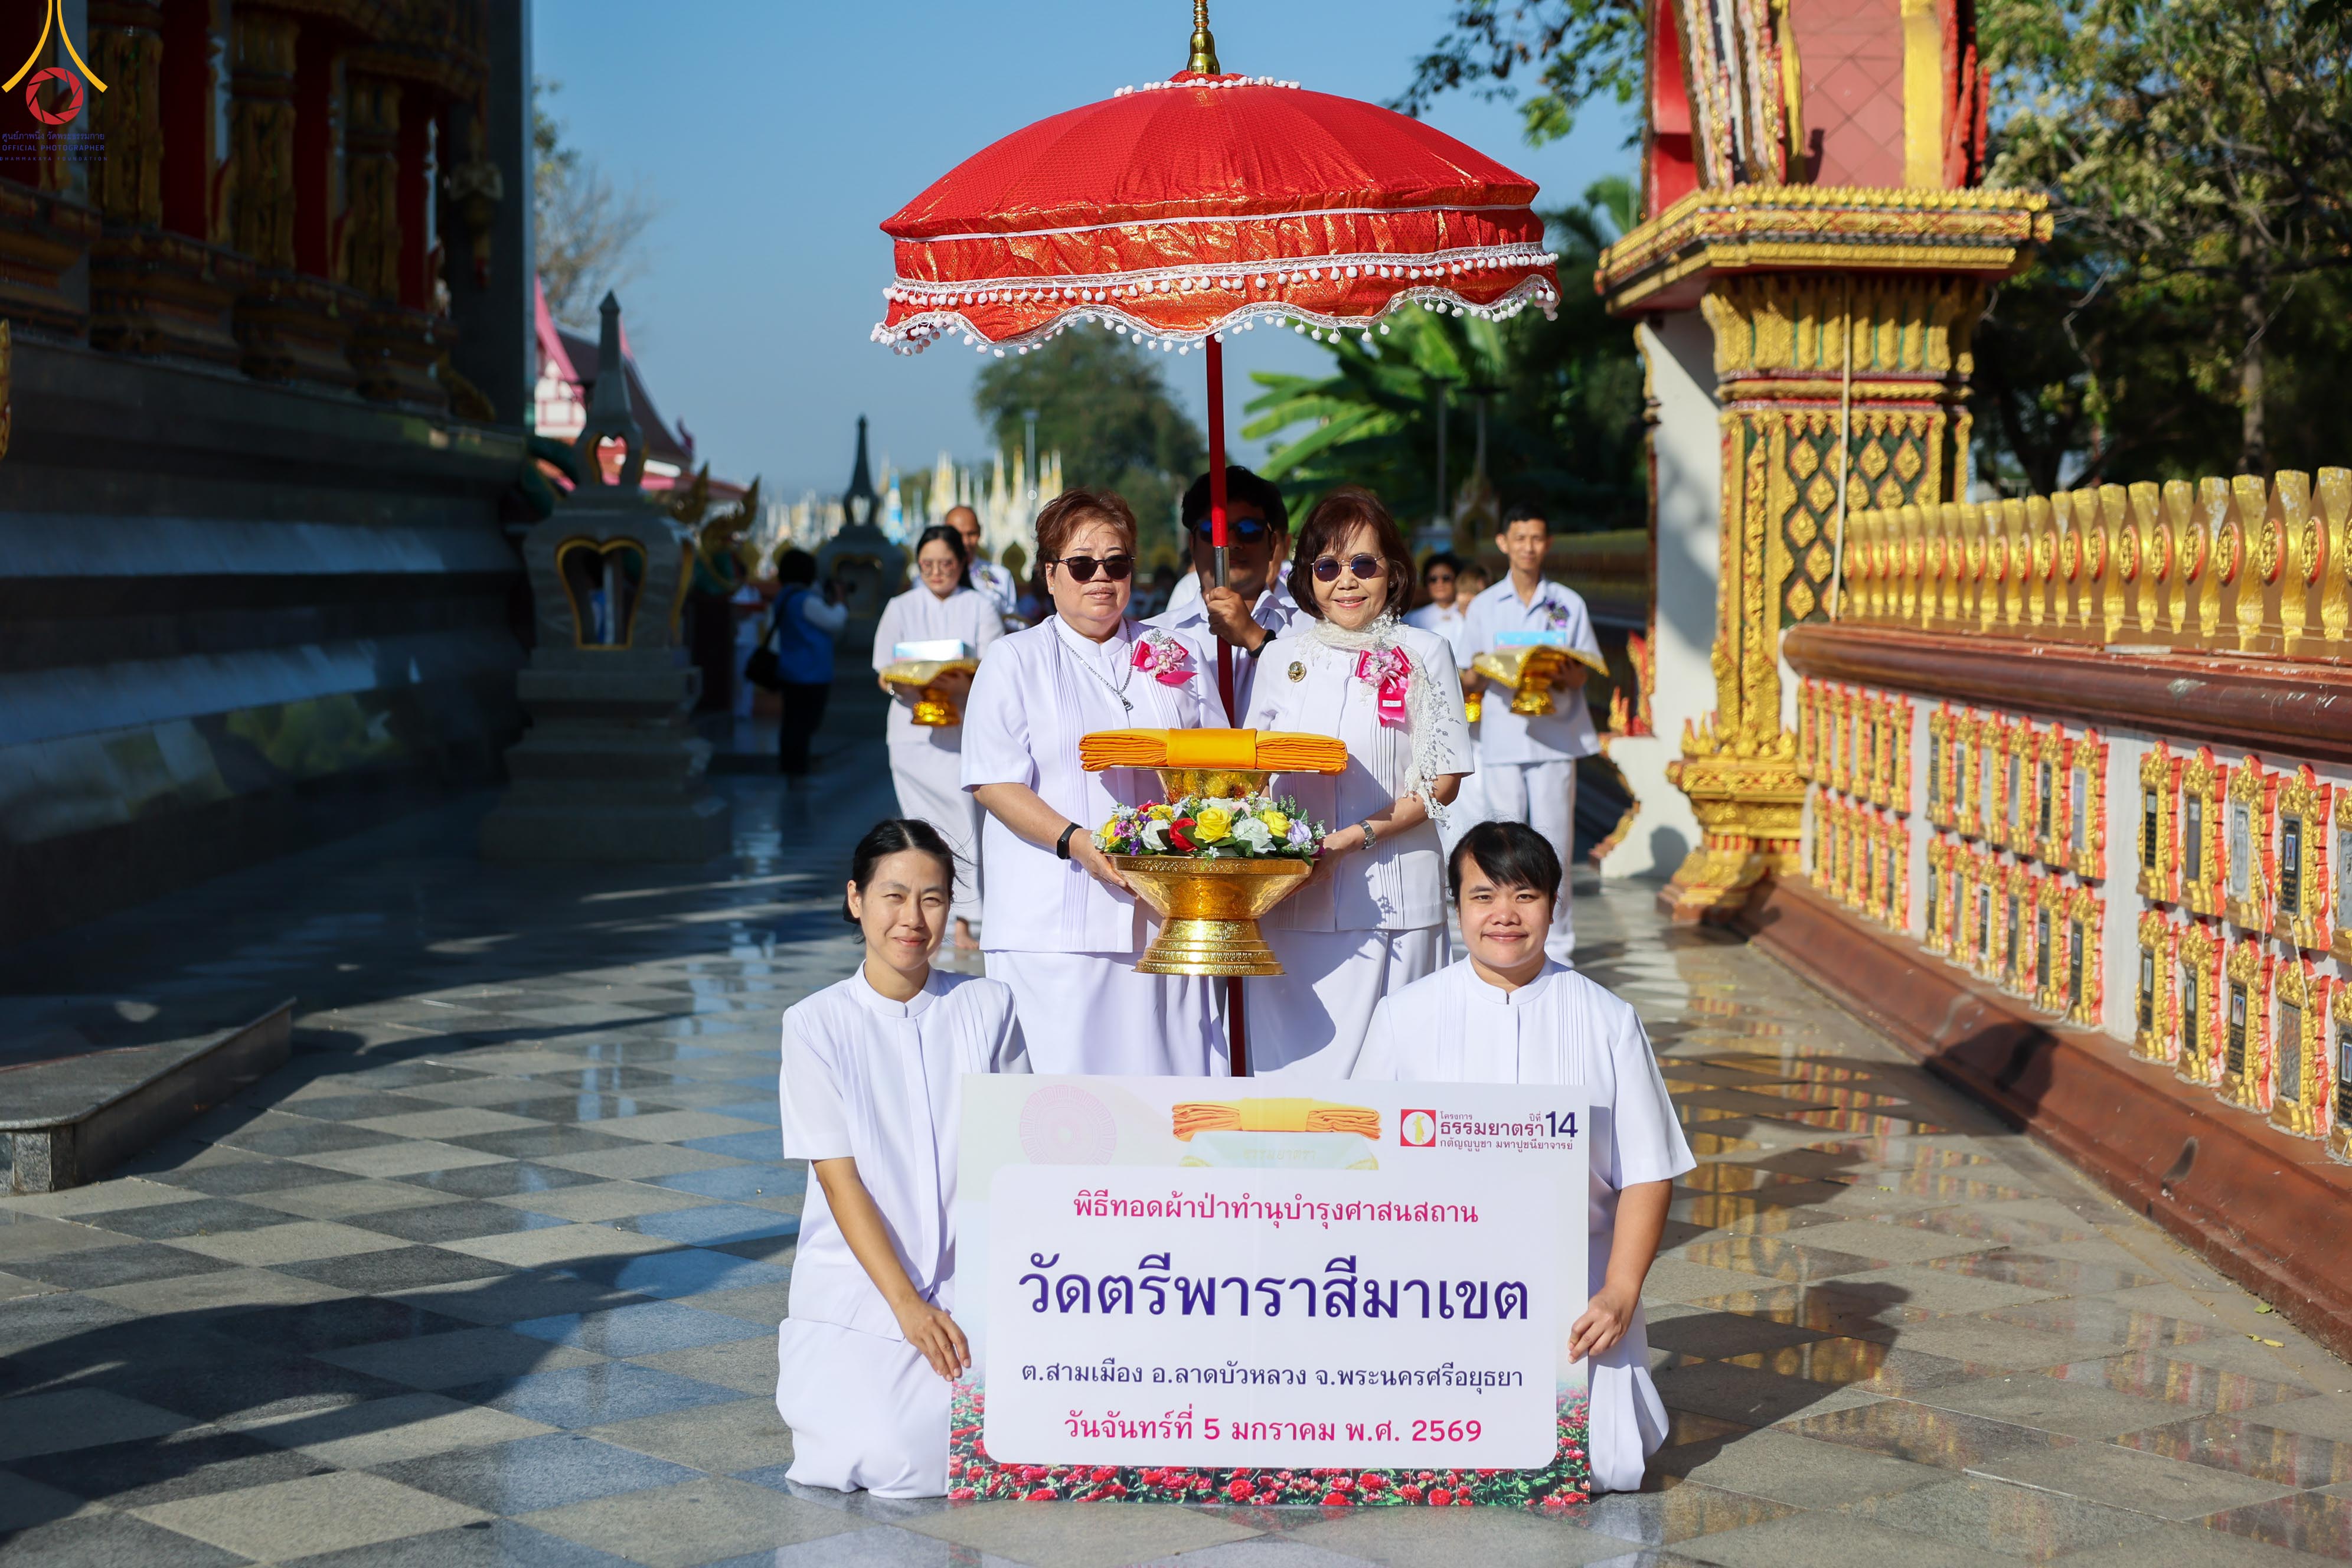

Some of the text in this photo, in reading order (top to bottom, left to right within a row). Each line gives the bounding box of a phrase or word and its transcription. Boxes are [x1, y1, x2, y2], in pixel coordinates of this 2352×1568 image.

[1440, 1110, 1473, 1121] โครงการ
[1440, 1121, 1544, 1136] ธรรมยาตรา
[1529, 1110, 1579, 1138] ปีที่ 14
[1073, 1189, 1479, 1230] พิธีทอดผ้าป่าทำนุบำรุงศาสนสถาน
[1018, 1252, 1528, 1320] วัดตรีพาราสีมาเขต
[1022, 1357, 1523, 1395] ต.สามเมือง อ.ลาดบัวหลวง จ.พระนครศรีอยุธยา
[1064, 1403, 1482, 1442] วันจันทร์ที่ 5 มกราคม พ.ศ. 2569
